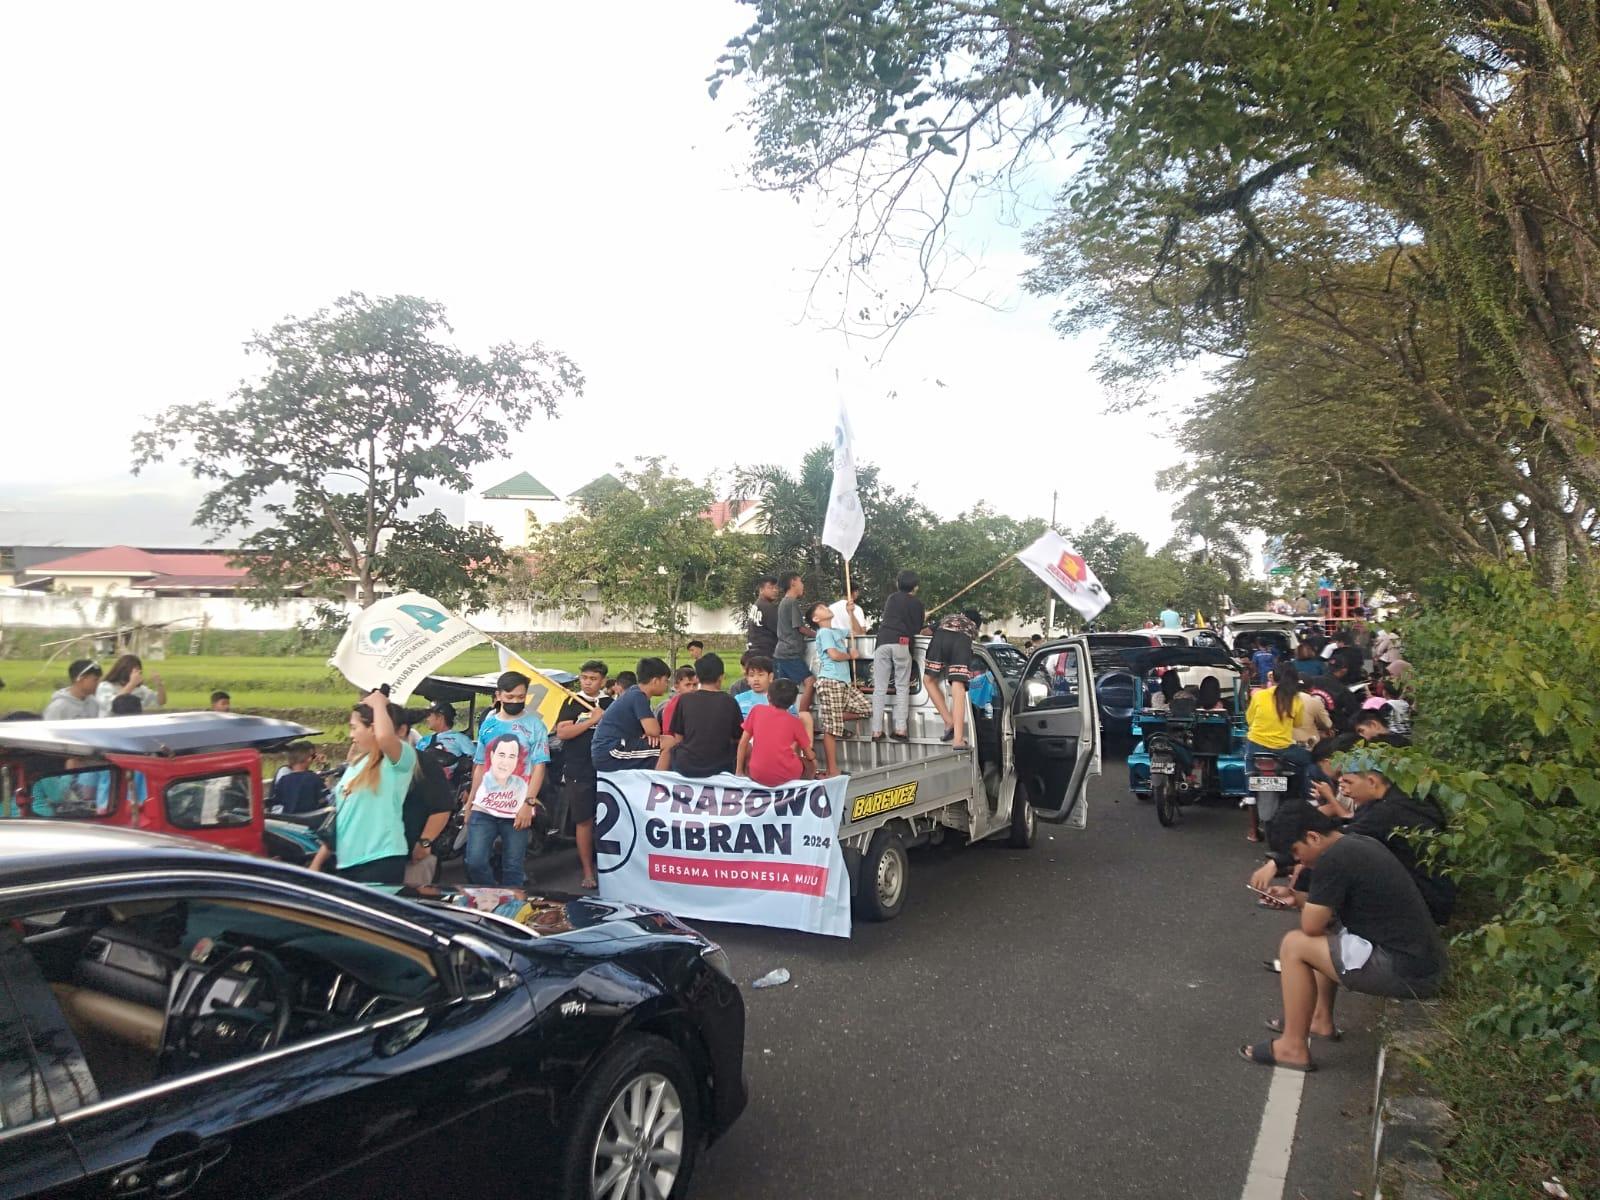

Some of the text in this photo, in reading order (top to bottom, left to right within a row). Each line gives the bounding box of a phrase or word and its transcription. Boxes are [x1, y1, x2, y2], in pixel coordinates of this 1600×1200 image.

[645, 782, 832, 819] PRABOWO
[853, 784, 917, 818] BAREWEZ
[597, 791, 621, 856] 2
[645, 817, 831, 856] GIBRAN 2024
[654, 863, 709, 878] BERSAMA
[715, 869, 790, 883] INDONESIA
